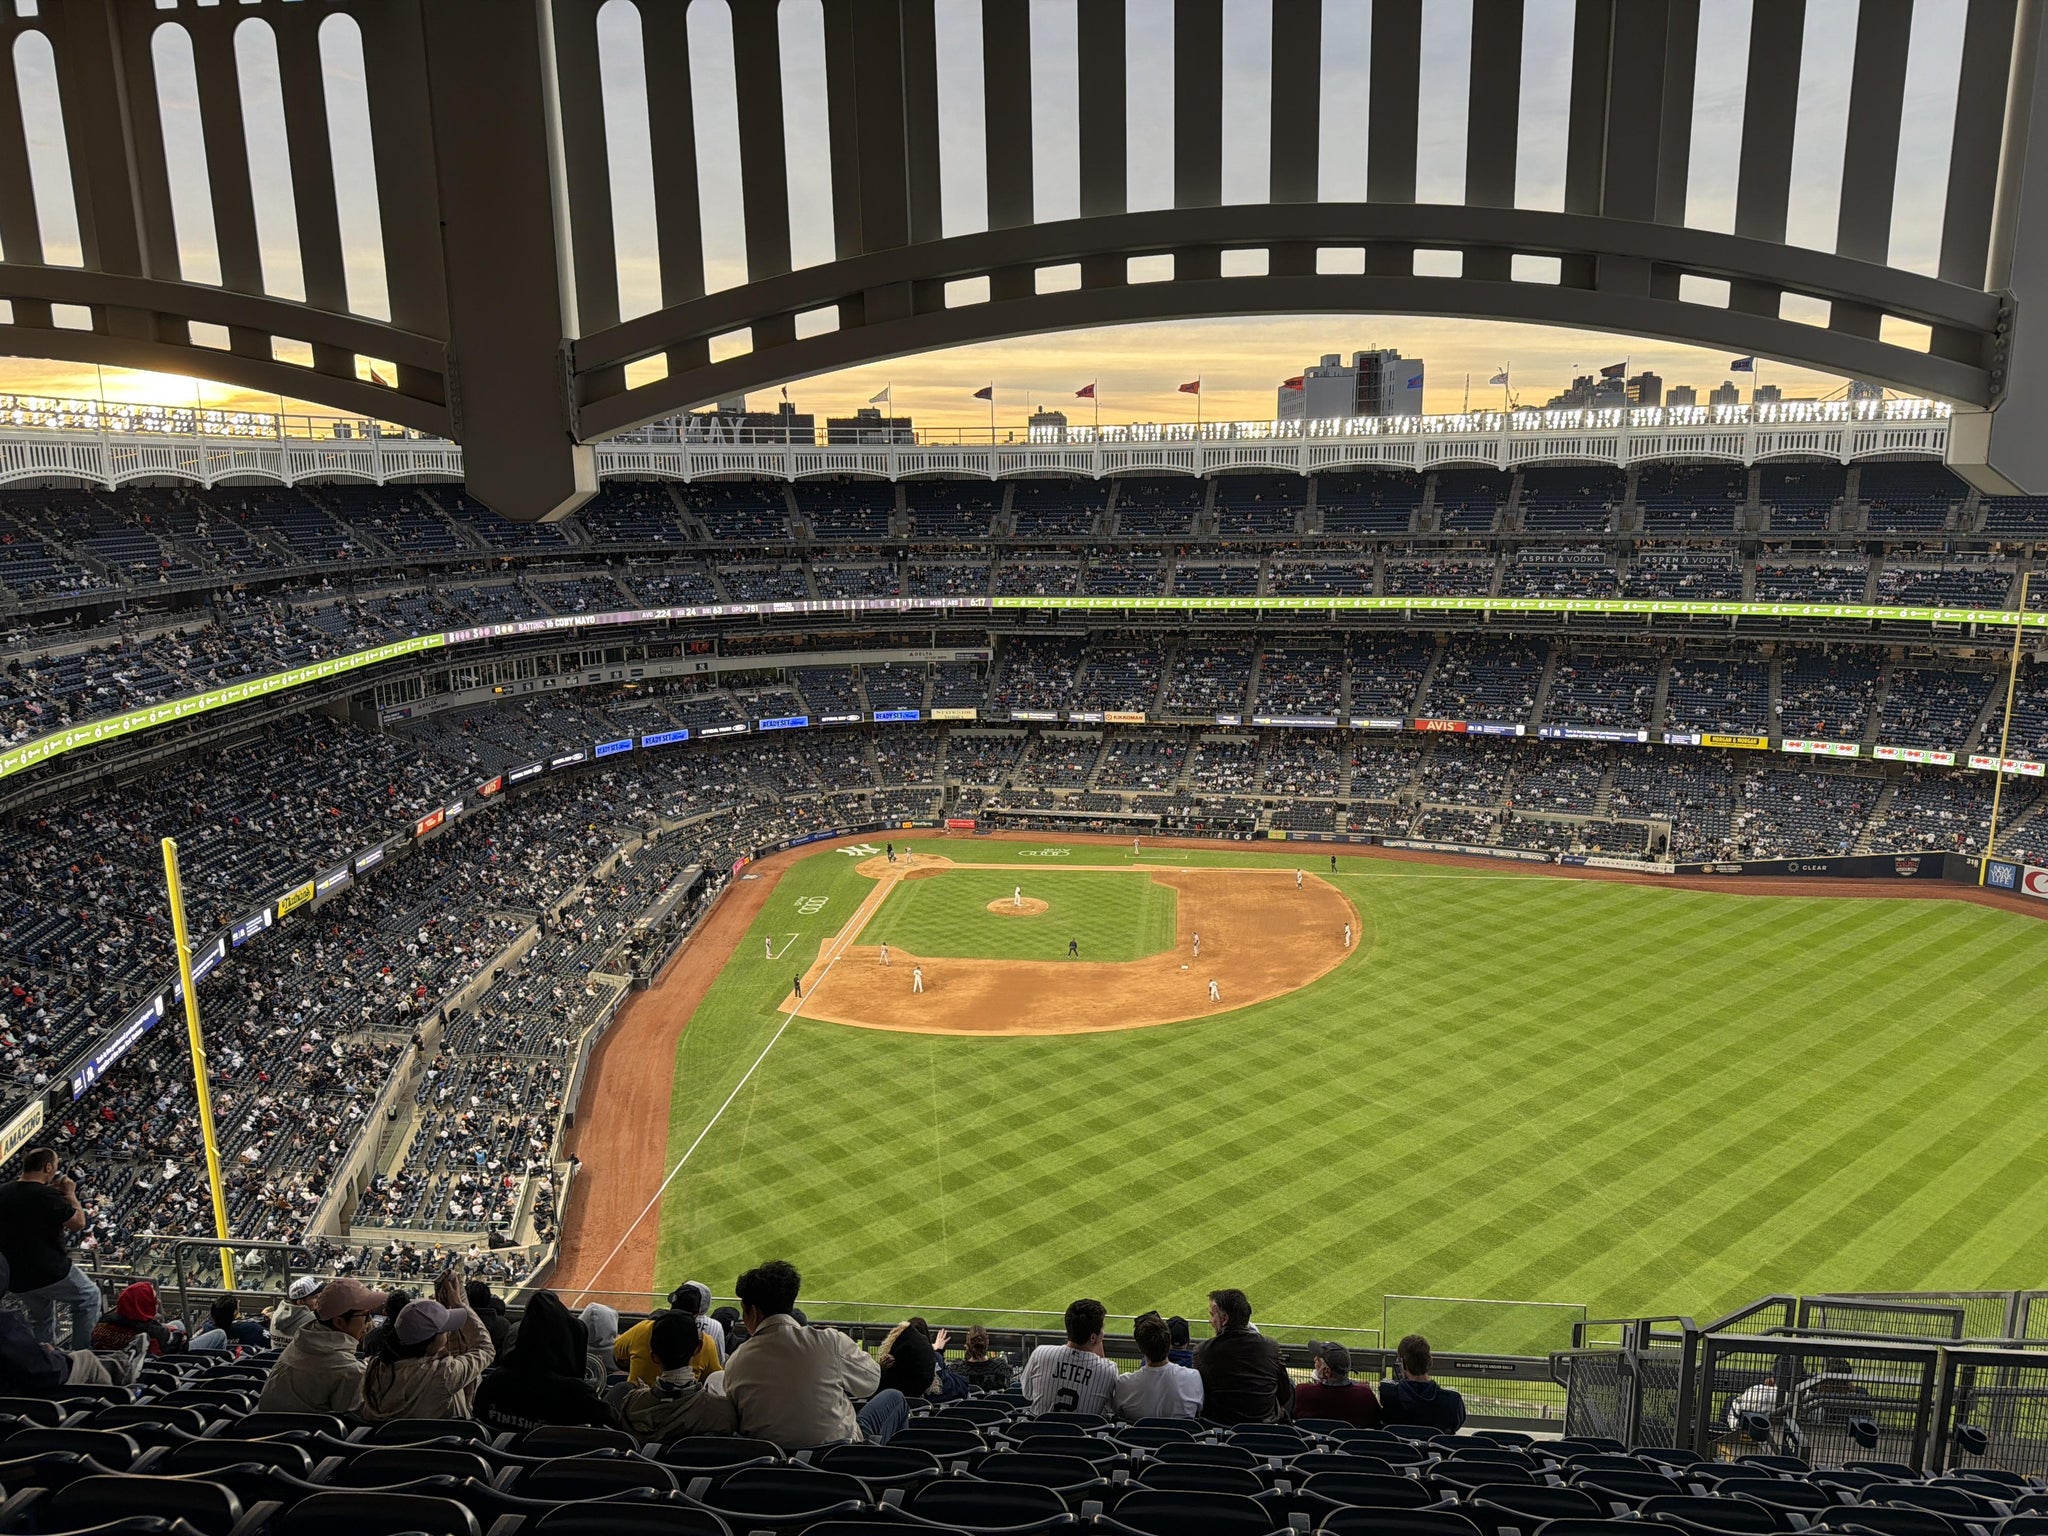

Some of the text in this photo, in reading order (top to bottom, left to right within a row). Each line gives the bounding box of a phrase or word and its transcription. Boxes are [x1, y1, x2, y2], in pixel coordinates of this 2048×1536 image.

[1521, 555, 1600, 563] ASPEN VODKA
[1643, 556, 1727, 564] ASPEN VODKA
[970, 598, 986, 606] 6:17
[686, 608, 697, 617] 24
[713, 607, 723, 615] 63
[575, 615, 596, 626] MAYO
[449, 632, 455, 643] B
[473, 628, 479, 638] S
[875, 712, 894, 720] READY
[894, 711, 903, 719] SET
[762, 720, 780, 729] READY
[780, 719, 790, 727] SET
[1426, 720, 1454, 731] AVIS
[645, 736, 662, 746] READY
[483, 781, 497, 796] AVIS
[1966, 857, 1979, 866] 318
[1993, 864, 2012, 875] NEW
[1990, 870, 2013, 881] YORK
[1992, 876, 2010, 885] LIFE
[4, 1111, 42, 1157] AMAZING
[1052, 1361, 1093, 1387] JETER
[1053, 1386, 1080, 1413] 2
[488, 1409, 541, 1430] FINISHE
